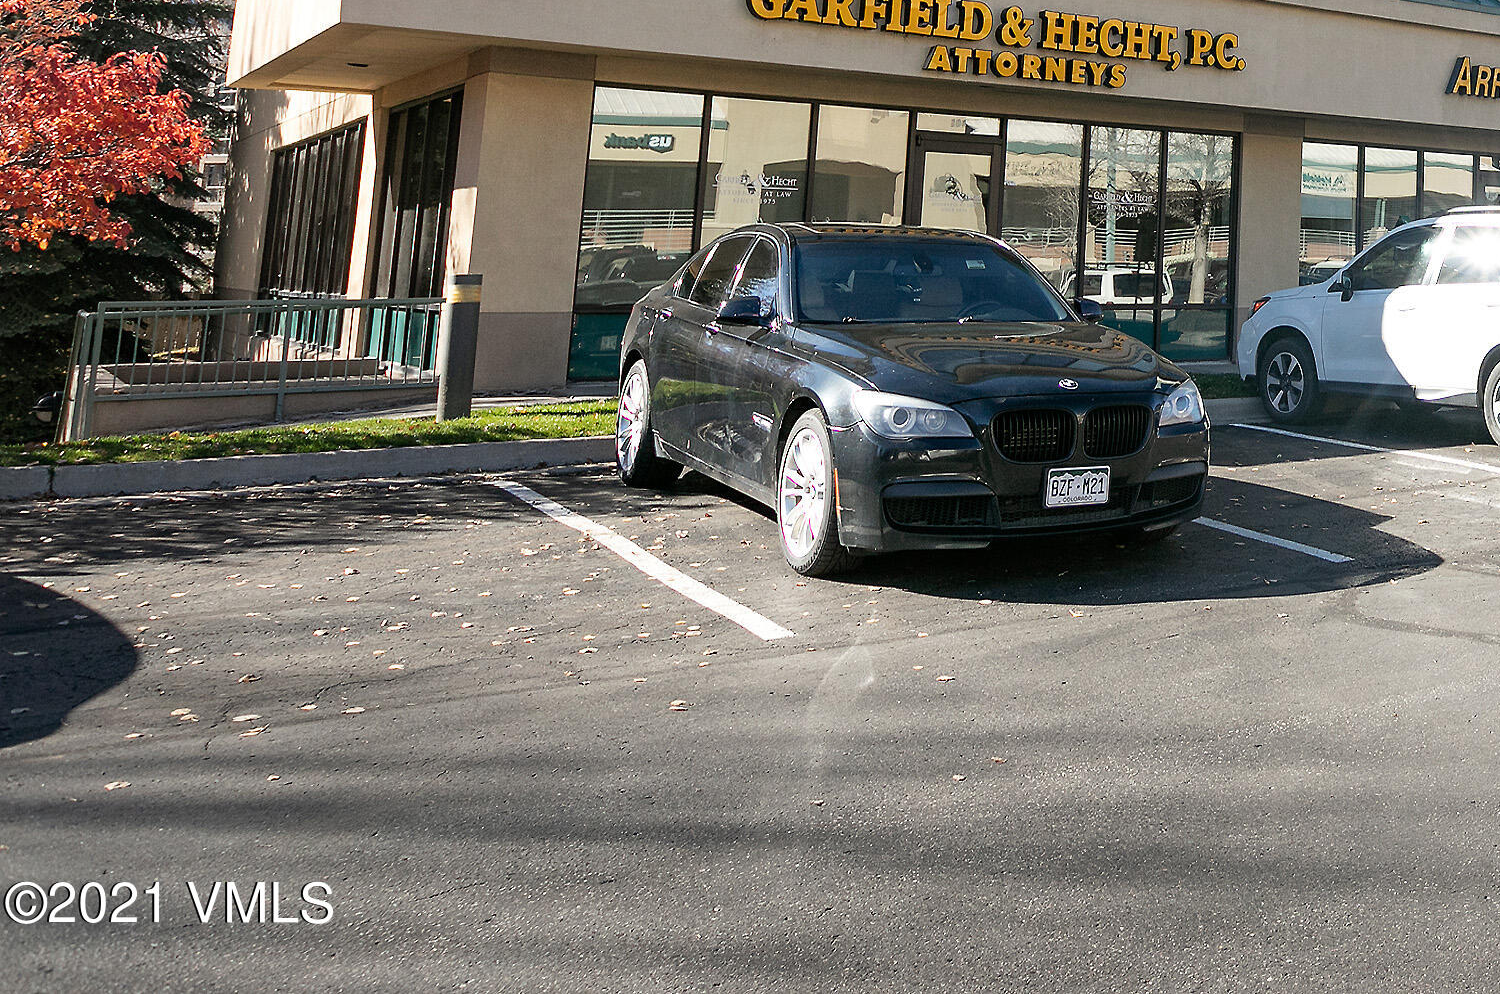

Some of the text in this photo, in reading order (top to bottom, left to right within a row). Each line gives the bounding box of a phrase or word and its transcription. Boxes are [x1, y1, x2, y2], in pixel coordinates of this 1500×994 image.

[996, 6, 1033, 48] &
[1038, 11, 1181, 71] HECHT,
[1185, 28, 1247, 71] P.C.
[924, 44, 1128, 88] ATTORNEYS
[771, 175, 797, 187] HECHT
[1120, 190, 1134, 203] &
